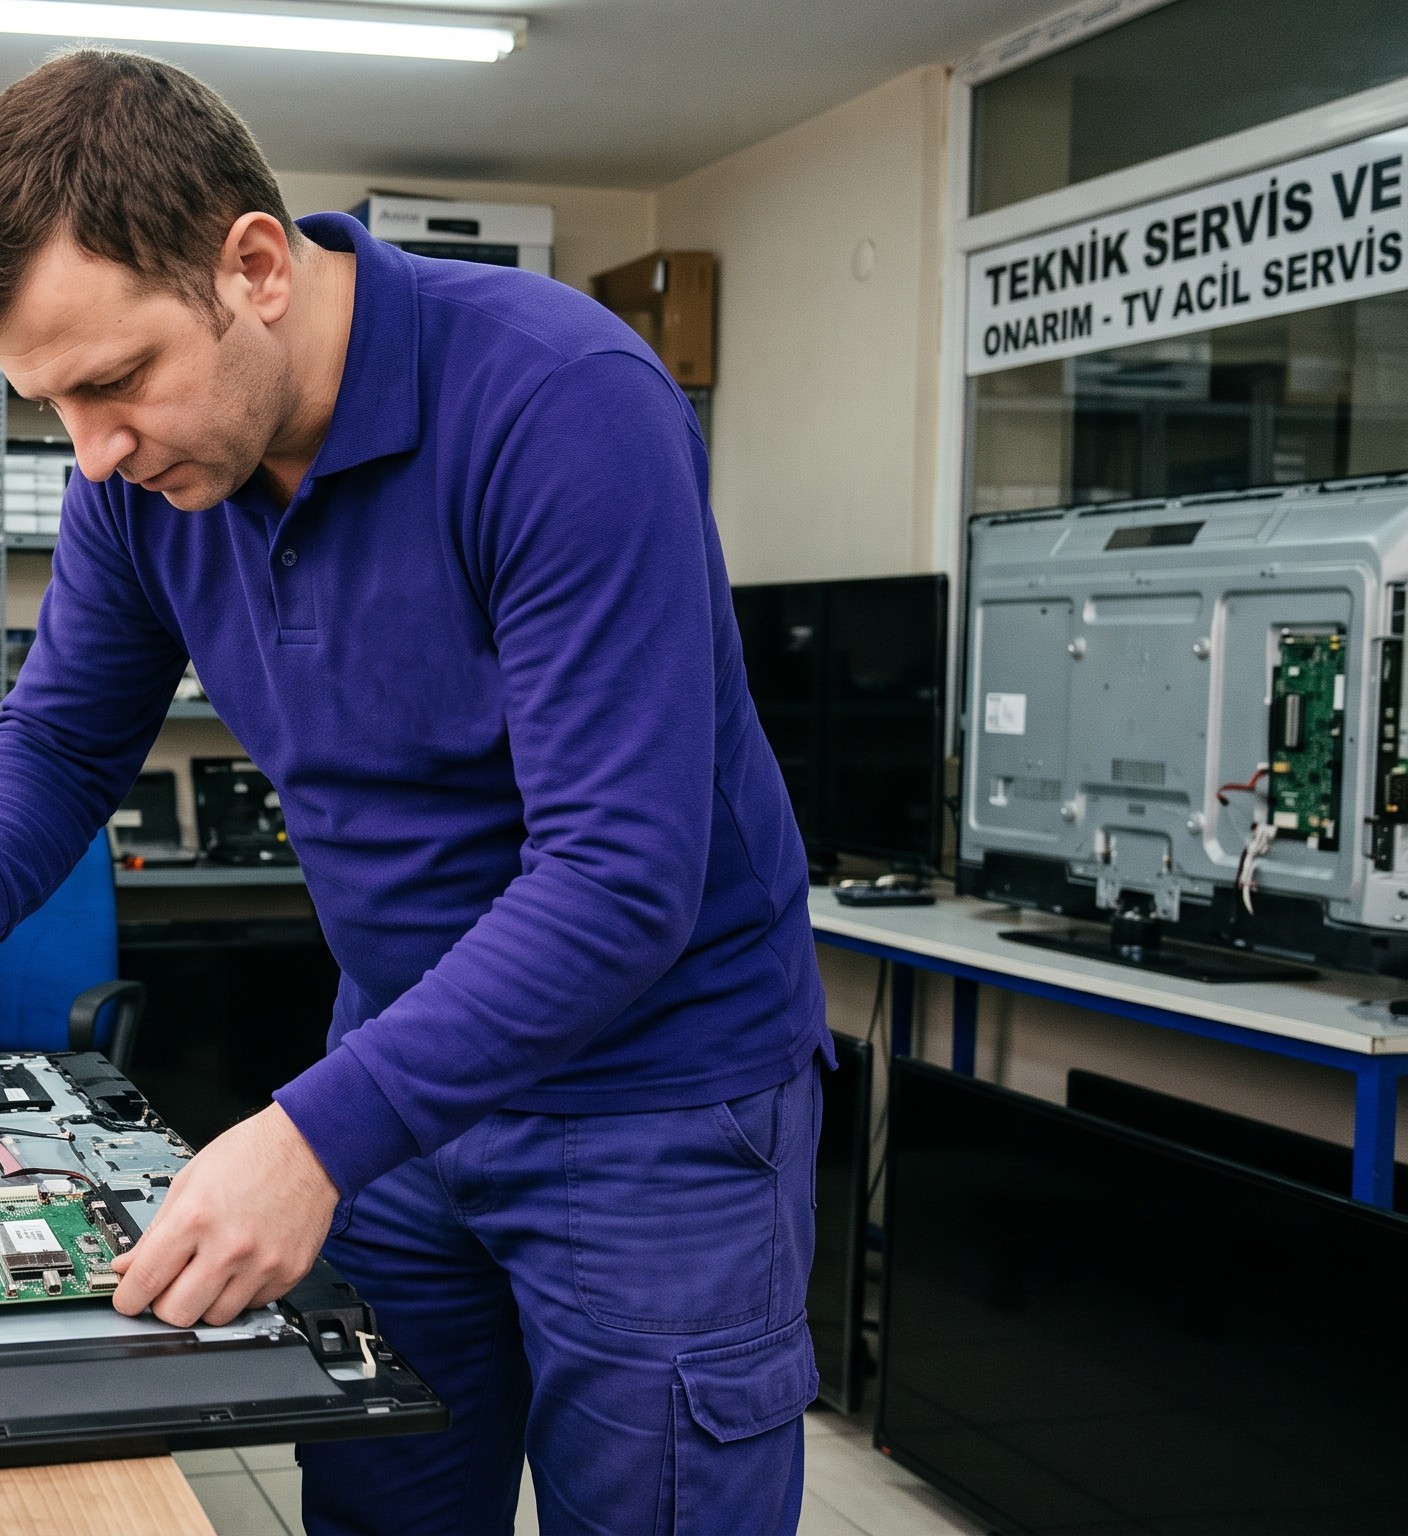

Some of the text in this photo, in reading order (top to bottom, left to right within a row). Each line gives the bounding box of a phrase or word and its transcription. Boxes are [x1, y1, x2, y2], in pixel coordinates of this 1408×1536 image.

[983, 226, 1404, 358] ONARIM - TV ACİL SERVİS
[984, 155, 1404, 306] TEKNİK SERVİS VE
